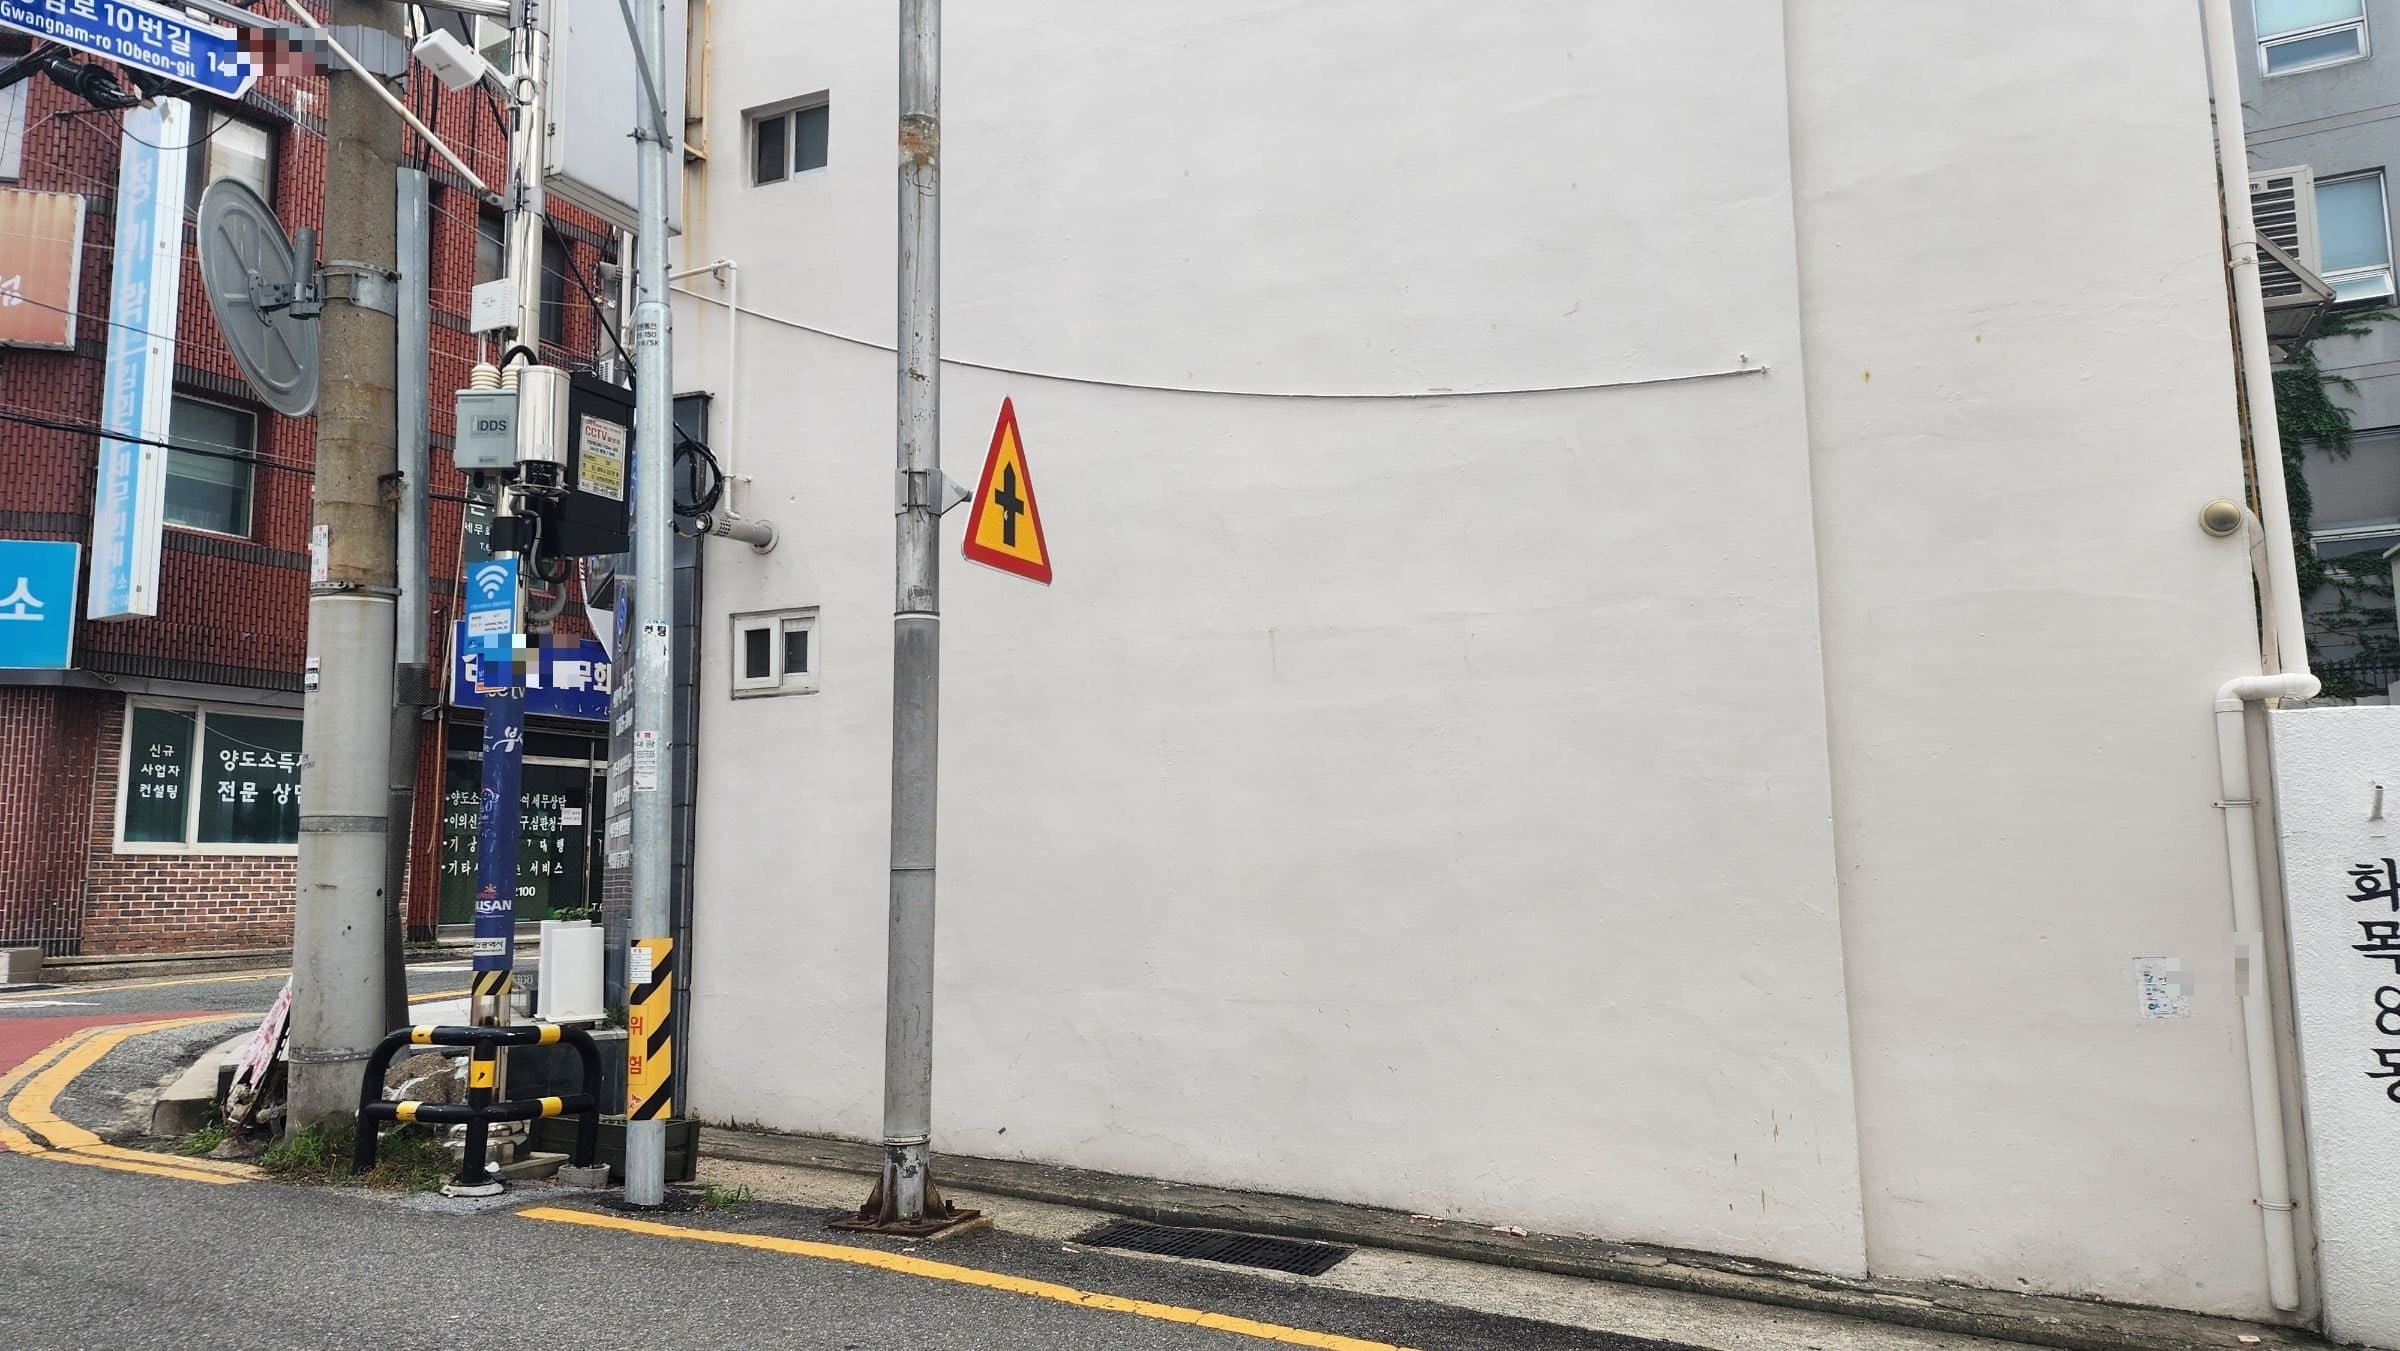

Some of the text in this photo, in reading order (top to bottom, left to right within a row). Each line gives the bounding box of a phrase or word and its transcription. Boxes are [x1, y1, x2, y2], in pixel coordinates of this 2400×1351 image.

[0, 0, 196, 78] Gwangnam-ro 10beon-gil
[585, 425, 608, 441] CCTV
[149, 743, 175, 758] 신규
[141, 763, 180, 778] 사업자
[139, 783, 178, 799] 컨설팅
[217, 780, 259, 803] 전문
